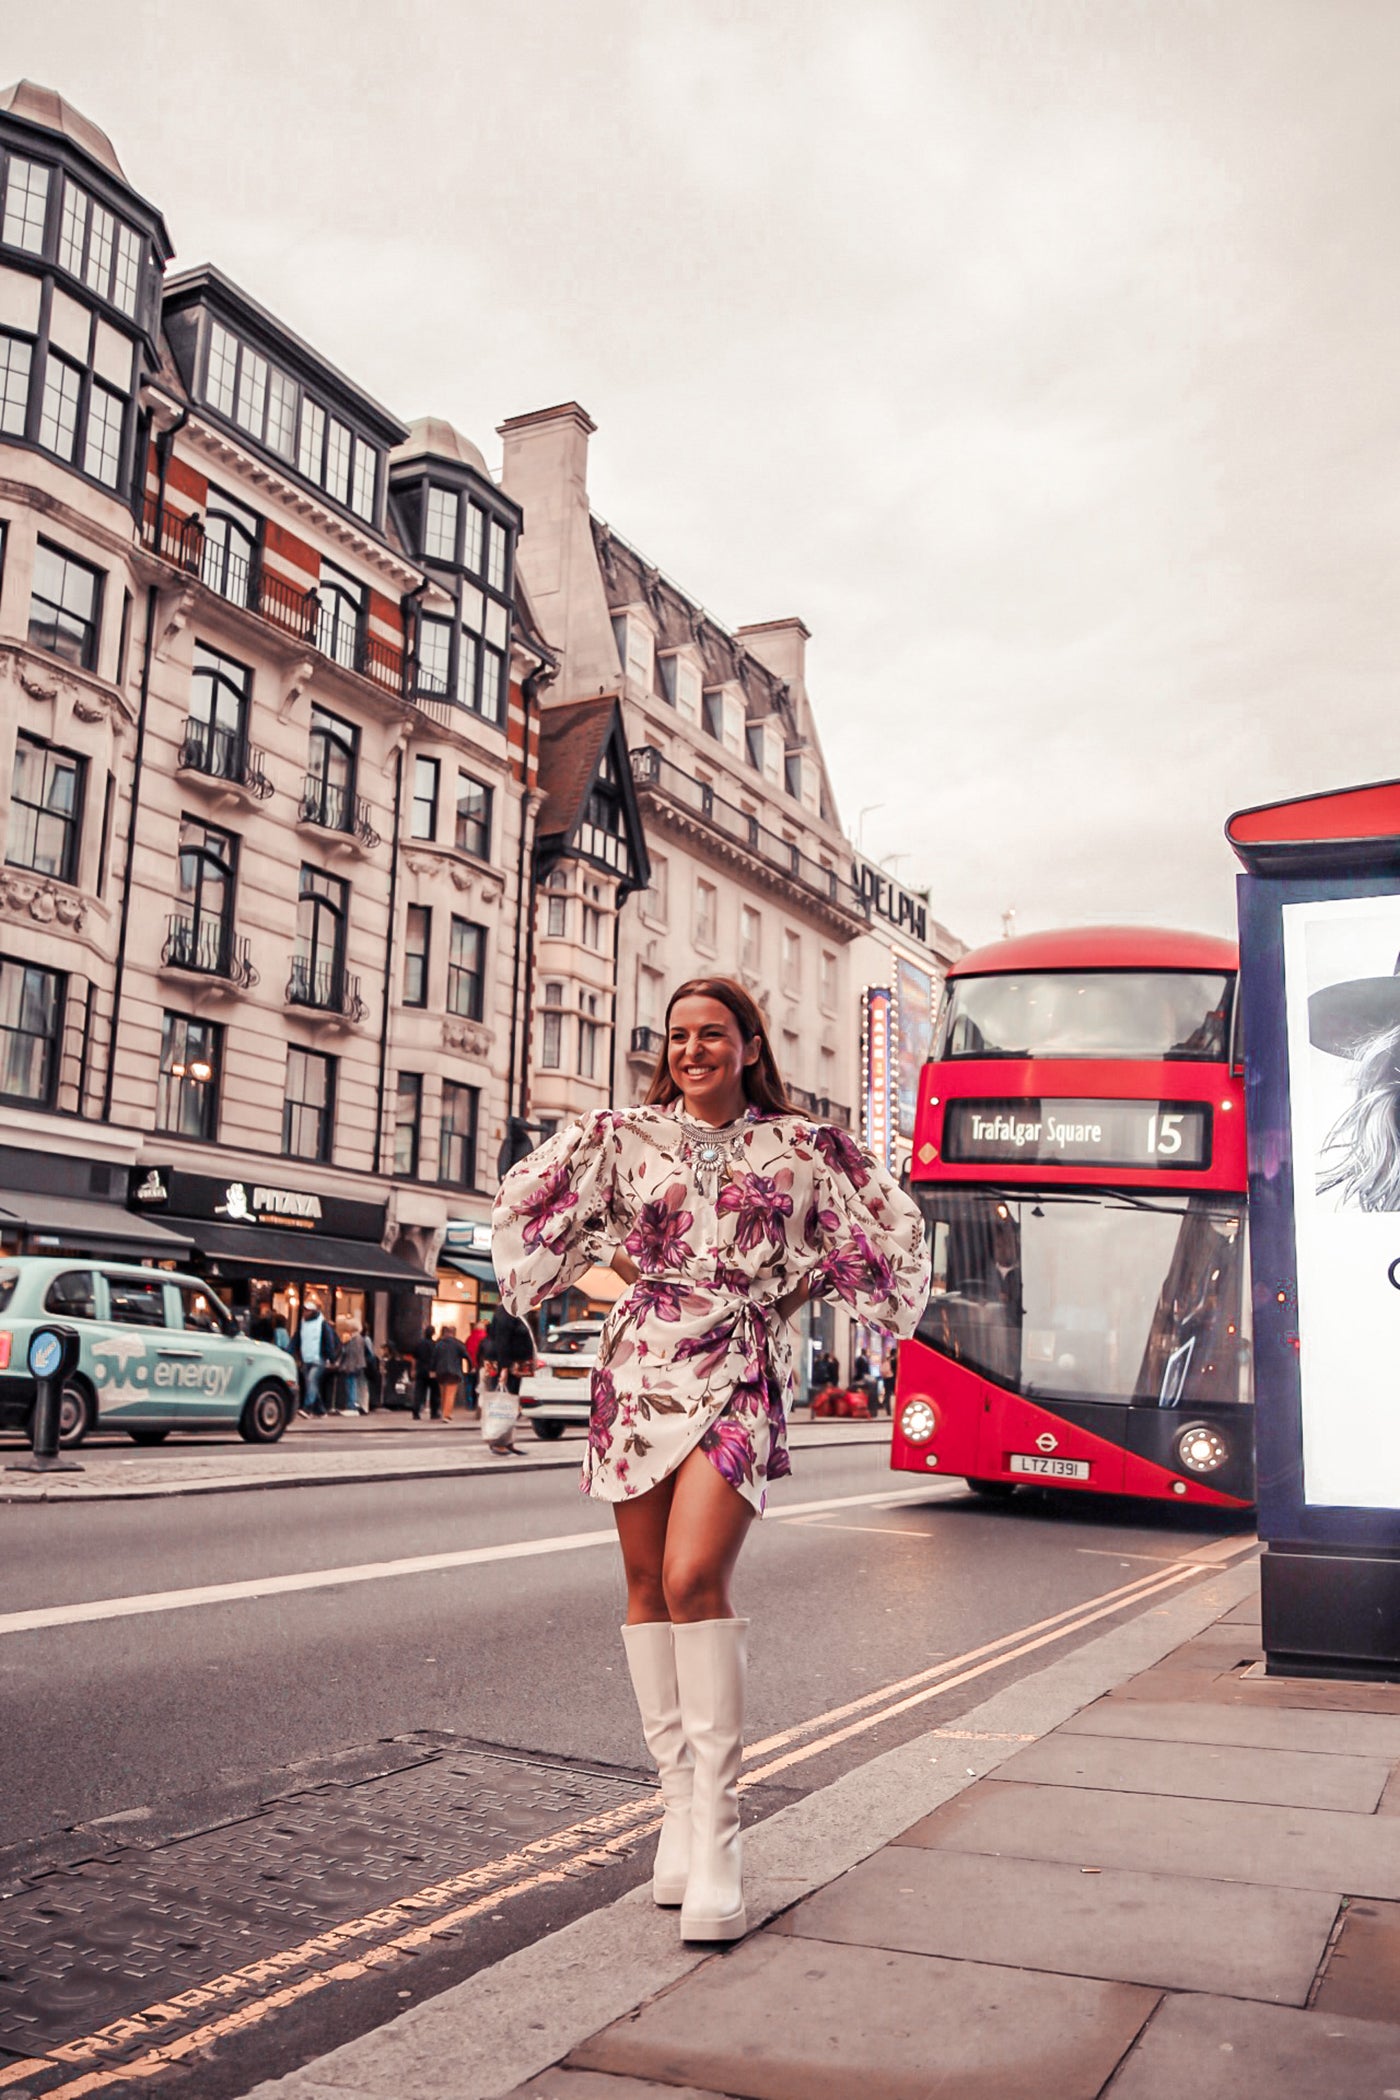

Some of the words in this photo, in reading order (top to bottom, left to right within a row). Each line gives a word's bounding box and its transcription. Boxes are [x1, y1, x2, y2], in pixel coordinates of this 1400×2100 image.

[971, 1115, 1042, 1146] Trafalgar
[1047, 1117, 1101, 1148] Square
[1147, 1114, 1185, 1154] 15
[253, 1187, 322, 1218] PITAYA
[154, 1361, 234, 1396] energy
[1022, 1458, 1049, 1473] LTZ
[1052, 1460, 1078, 1476] 1391
